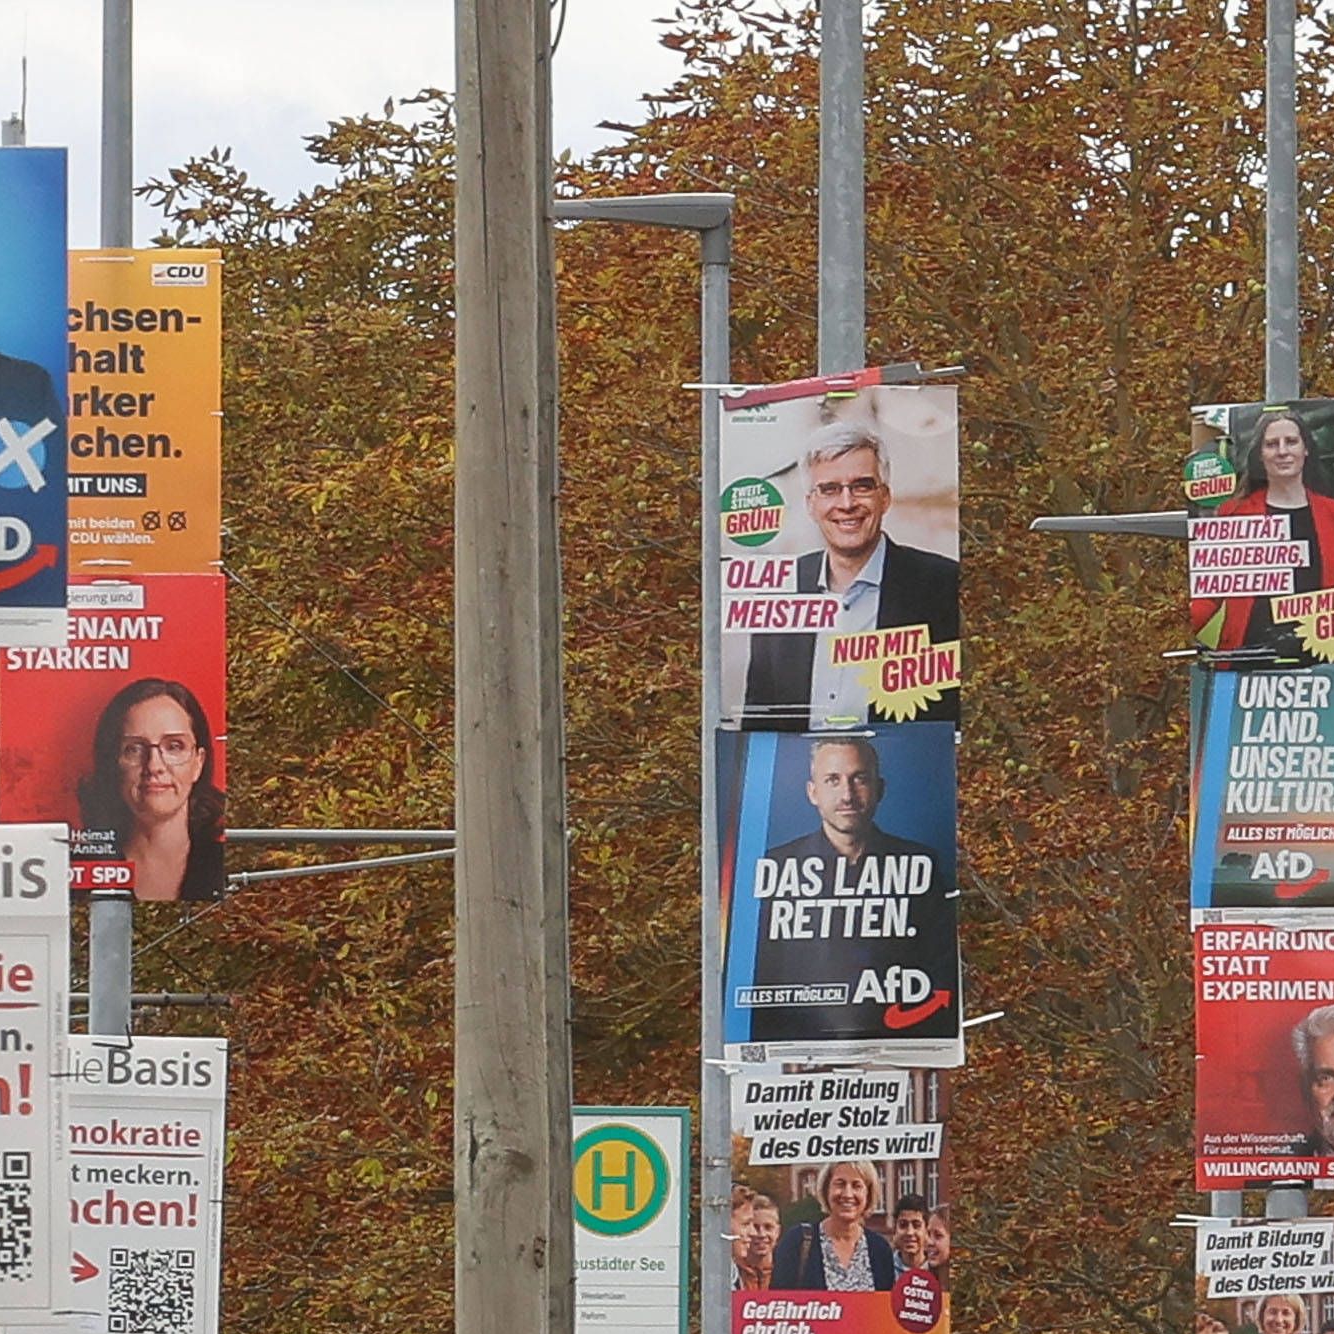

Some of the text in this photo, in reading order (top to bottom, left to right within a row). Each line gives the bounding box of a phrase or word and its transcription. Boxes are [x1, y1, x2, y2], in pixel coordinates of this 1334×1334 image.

[166, 266, 205, 278] CDU
[67, 385, 155, 417] rker
[96, 477, 143, 494] UNS.
[89, 517, 135, 530] beiden
[725, 508, 781, 535] GRÜN!
[1192, 516, 1285, 542] MOBILITÄT,
[70, 532, 155, 545] CDU wählen.
[1192, 545, 1305, 568] MAGDEBURG,
[726, 560, 794, 589] OLAF
[1194, 572, 1291, 594] MADELEINE
[110, 592, 134, 602] und
[725, 599, 840, 629] MEISTER
[1276, 599, 1314, 620] NUR
[832, 629, 924, 665] NUR MIT
[881, 647, 963, 692] GRÜN.
[1238, 676, 1331, 709] UNSER
[1241, 711, 1324, 743] LAND.
[71, 829, 116, 841] Heimat
[1227, 827, 1264, 841] ALLES
[1265, 826, 1284, 840] IST
[92, 867, 131, 883] SPD
[1250, 850, 1314, 880] AfD
[754, 855, 933, 899] DAS LAND
[769, 898, 917, 941] RETTEN.
[1202, 955, 1270, 976] STATT
[739, 983, 845, 1003] ALLES IST MÖGLICH.
[852, 965, 933, 1004] AfD
[745, 1078, 900, 1105] Damit Bildung
[753, 1105, 890, 1131] wieder Stolz
[759, 1131, 936, 1160] des Ostens wird!
[1203, 1144, 1219, 1154] Für
[1223, 1133, 1239, 1143] der
[87, 1164, 200, 1187] meckern.
[1203, 1161, 1320, 1177] WILLINGMANN
[1206, 1229, 1325, 1251] Damit Bildung
[640, 1257, 666, 1271] See
[1210, 1250, 1316, 1272] wieder Stolz
[903, 1286, 935, 1301] OSTEN
[1215, 1274, 1244, 1293] des
[1247, 1272, 1308, 1292] Ostens
[742, 1301, 842, 1321] Gefährlich
